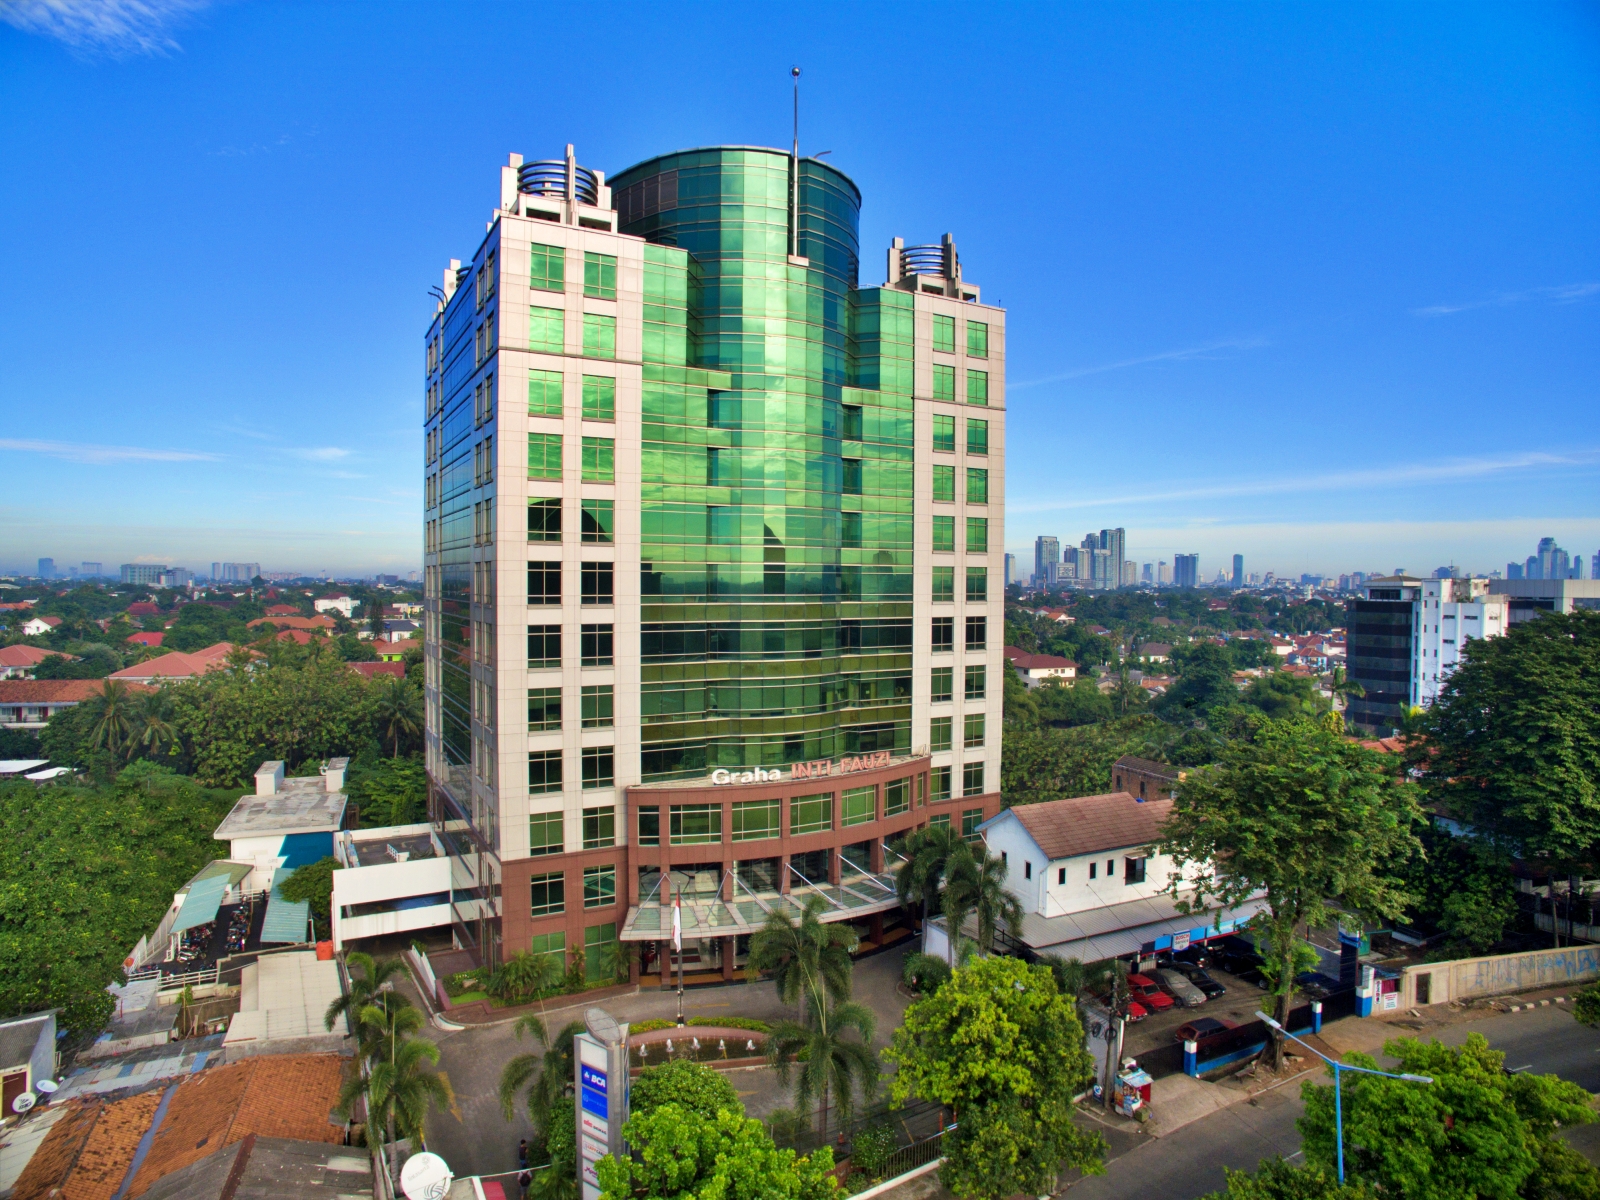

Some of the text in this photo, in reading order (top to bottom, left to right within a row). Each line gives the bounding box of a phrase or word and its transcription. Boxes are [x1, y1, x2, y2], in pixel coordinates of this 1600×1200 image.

[712, 751, 891, 785] Graha INTI FAUZI
[591, 1074, 606, 1088] BCA
